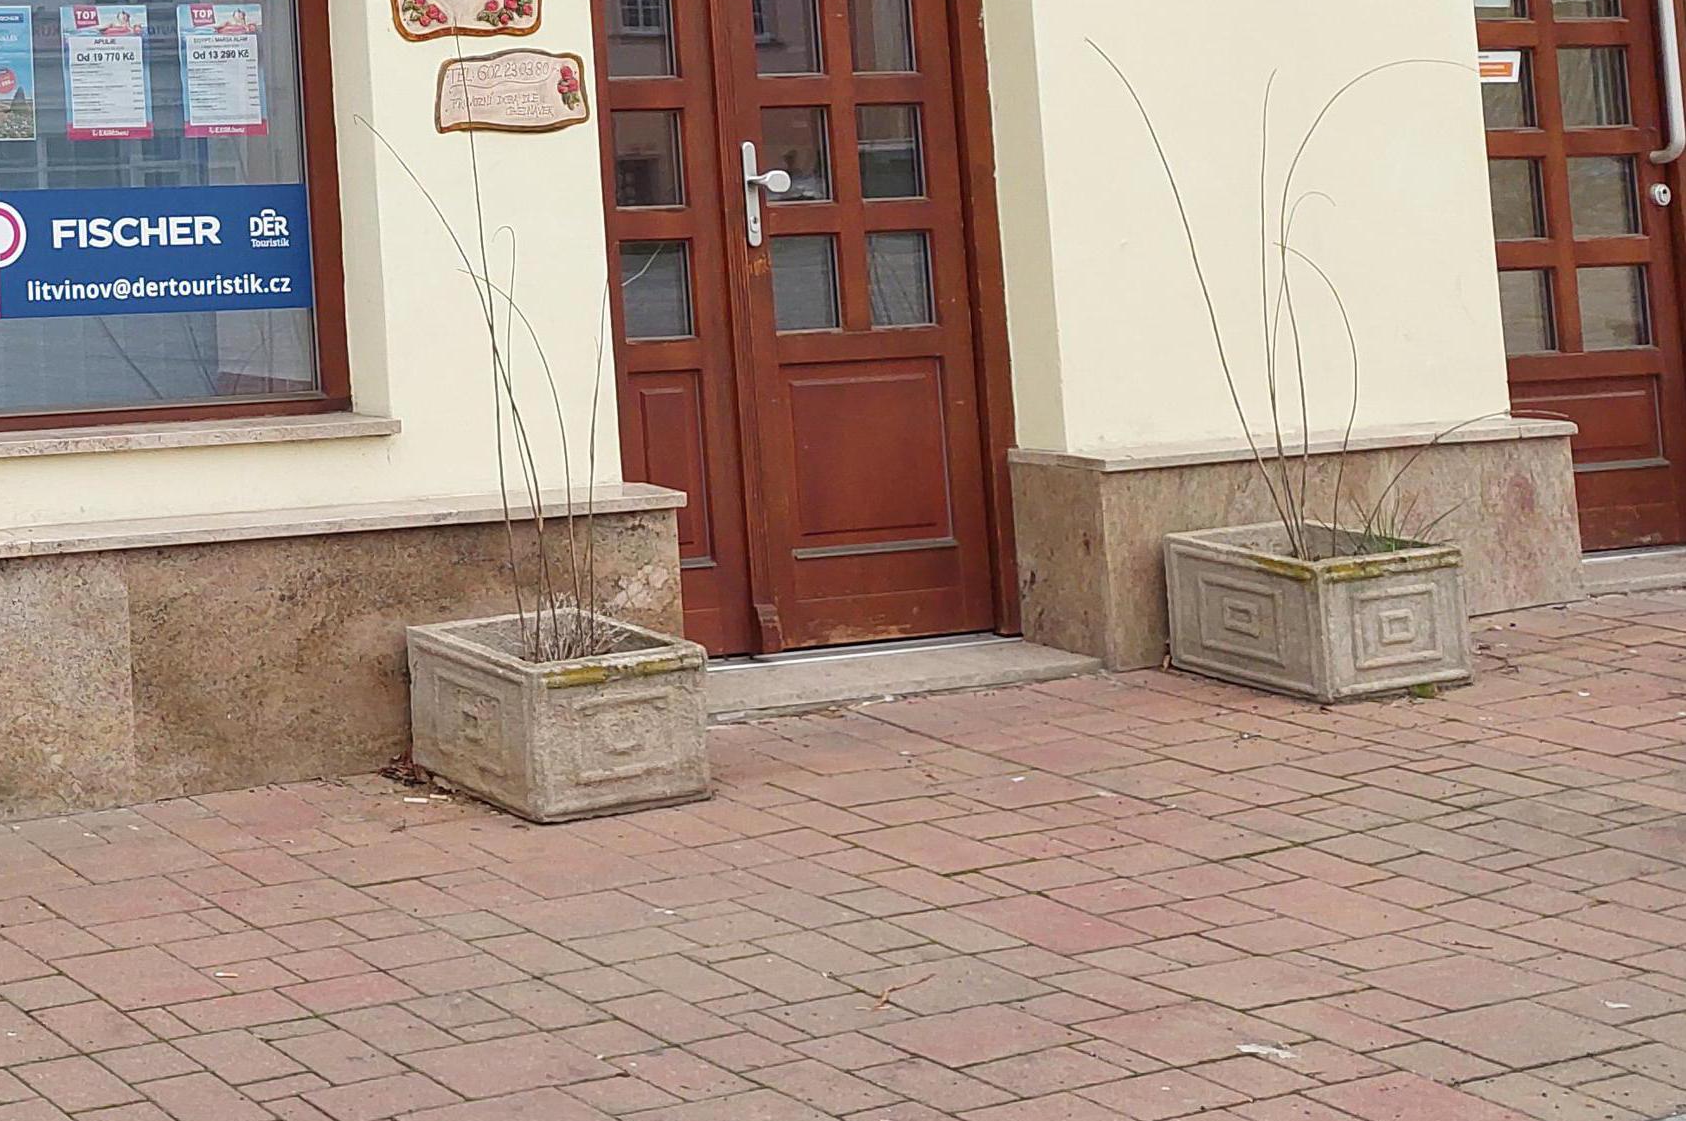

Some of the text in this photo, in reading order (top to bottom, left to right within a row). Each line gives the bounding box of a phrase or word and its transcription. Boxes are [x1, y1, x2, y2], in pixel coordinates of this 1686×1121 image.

[76, 10, 96, 20] TOP
[192, 9, 212, 18] TOP
[76, 53, 90, 62] Od
[123, 52, 135, 61] Kč
[193, 51, 206, 60] Od
[209, 51, 219, 59] 13
[238, 49, 250, 58] Kč
[52, 215, 221, 248] FISCHER
[251, 238, 290, 248] Touristik
[27, 273, 292, 301] litvinov@dertouristik.cz
